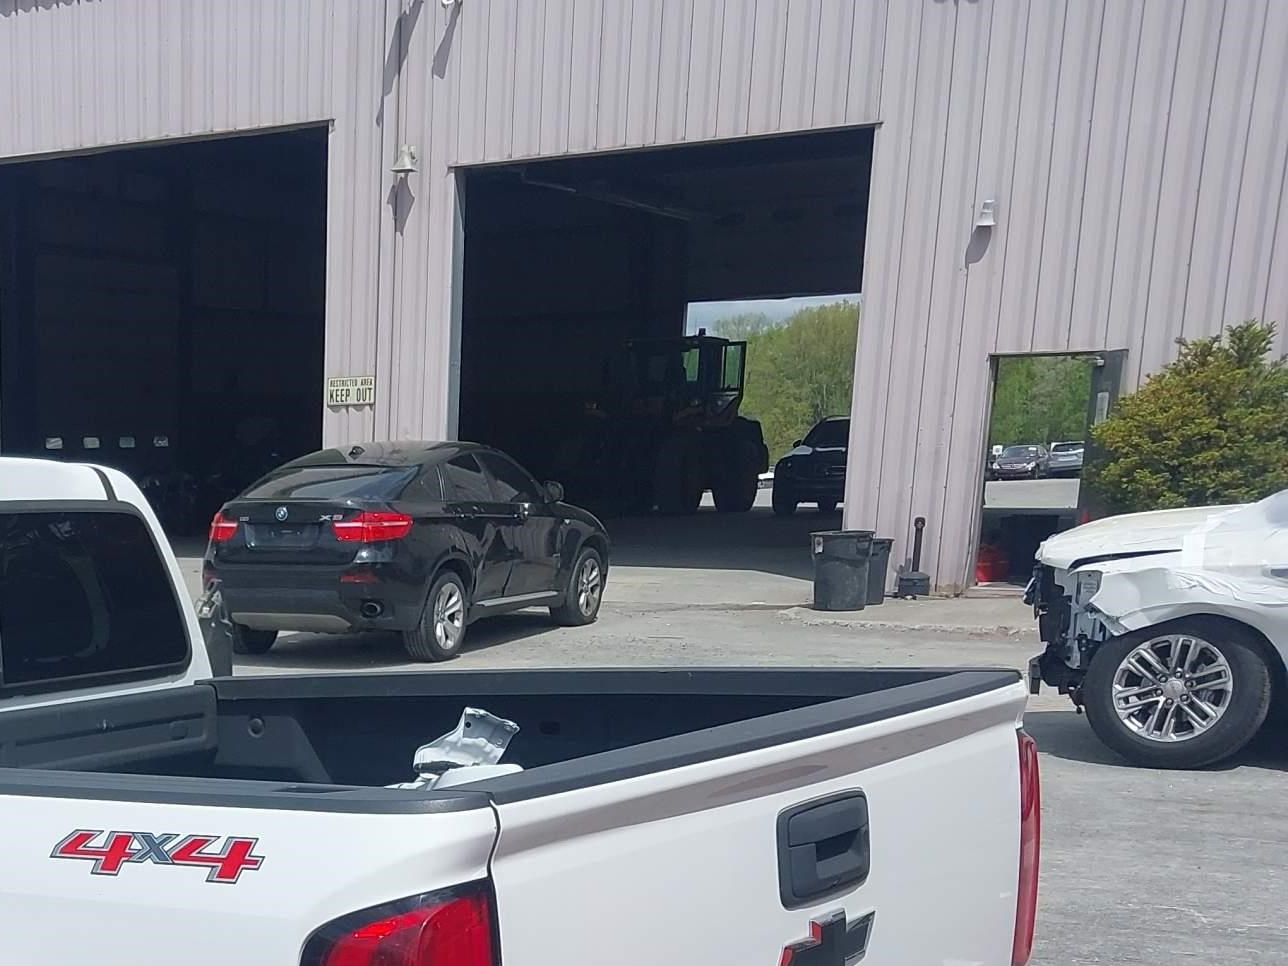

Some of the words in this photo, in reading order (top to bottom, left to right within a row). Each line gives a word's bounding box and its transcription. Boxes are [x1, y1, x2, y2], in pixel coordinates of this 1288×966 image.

[330, 379, 358, 388] RESTRICTED
[361, 378, 373, 386] AREA
[329, 388, 351, 403] KEEP
[356, 387, 373, 402] OUT
[49, 829, 266, 884] 4X4
